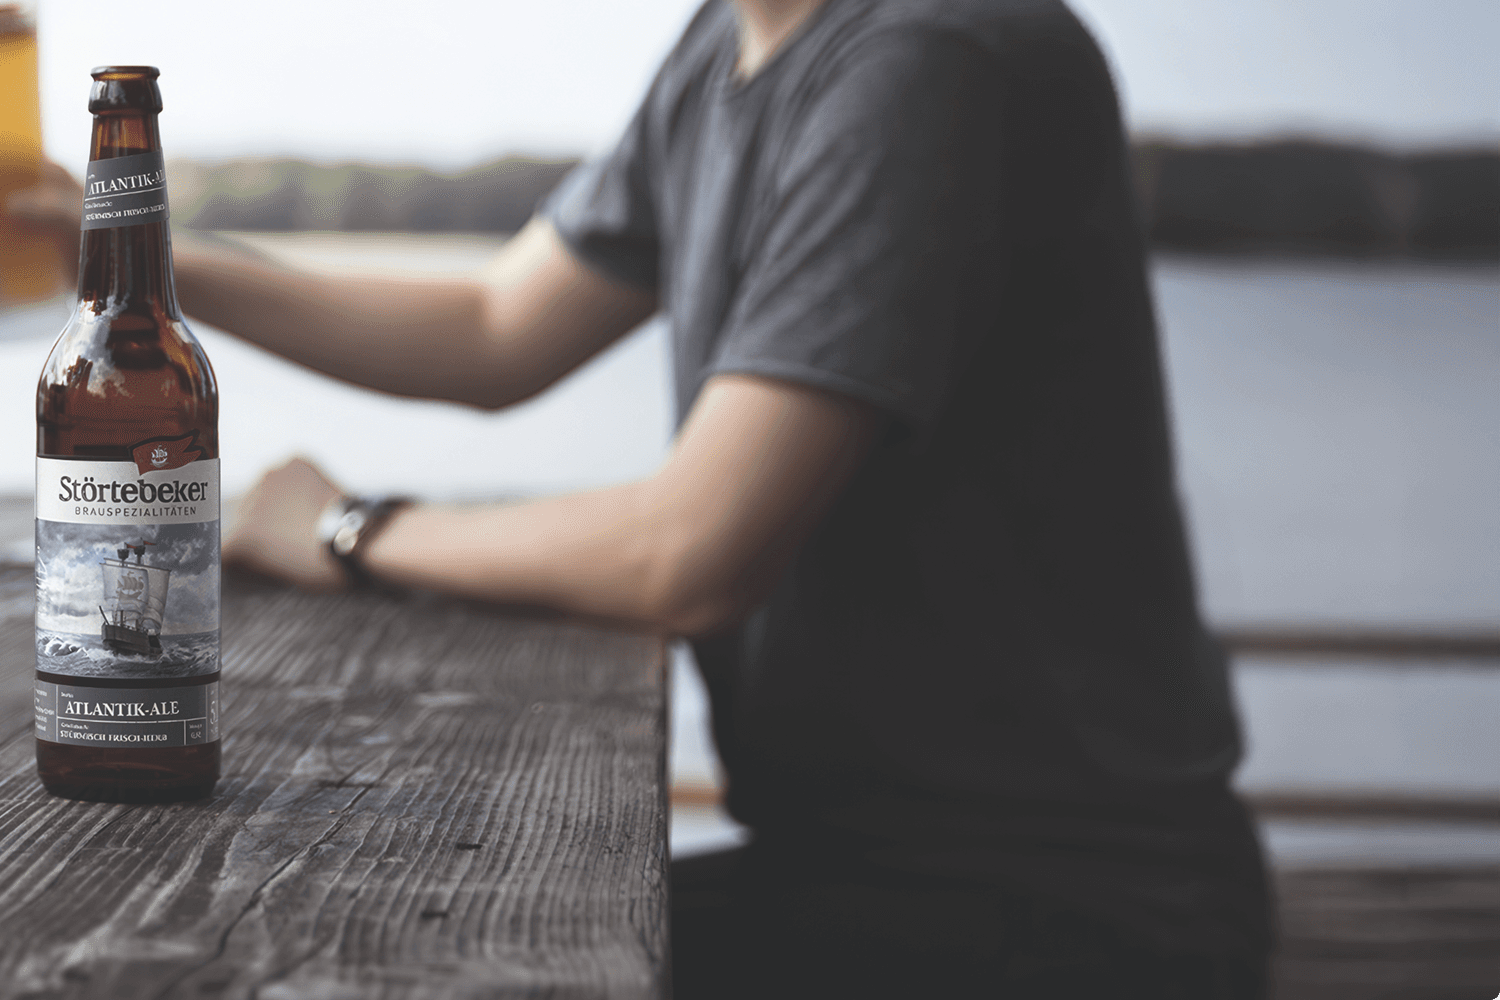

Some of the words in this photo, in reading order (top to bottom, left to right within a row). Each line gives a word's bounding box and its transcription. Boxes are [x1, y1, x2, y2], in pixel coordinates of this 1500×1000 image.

[58, 475, 208, 504] Störtebeker
[74, 505, 197, 517] BRAUSPEZIALITÄTEN
[64, 700, 180, 717] ATLANTIK-ALE
